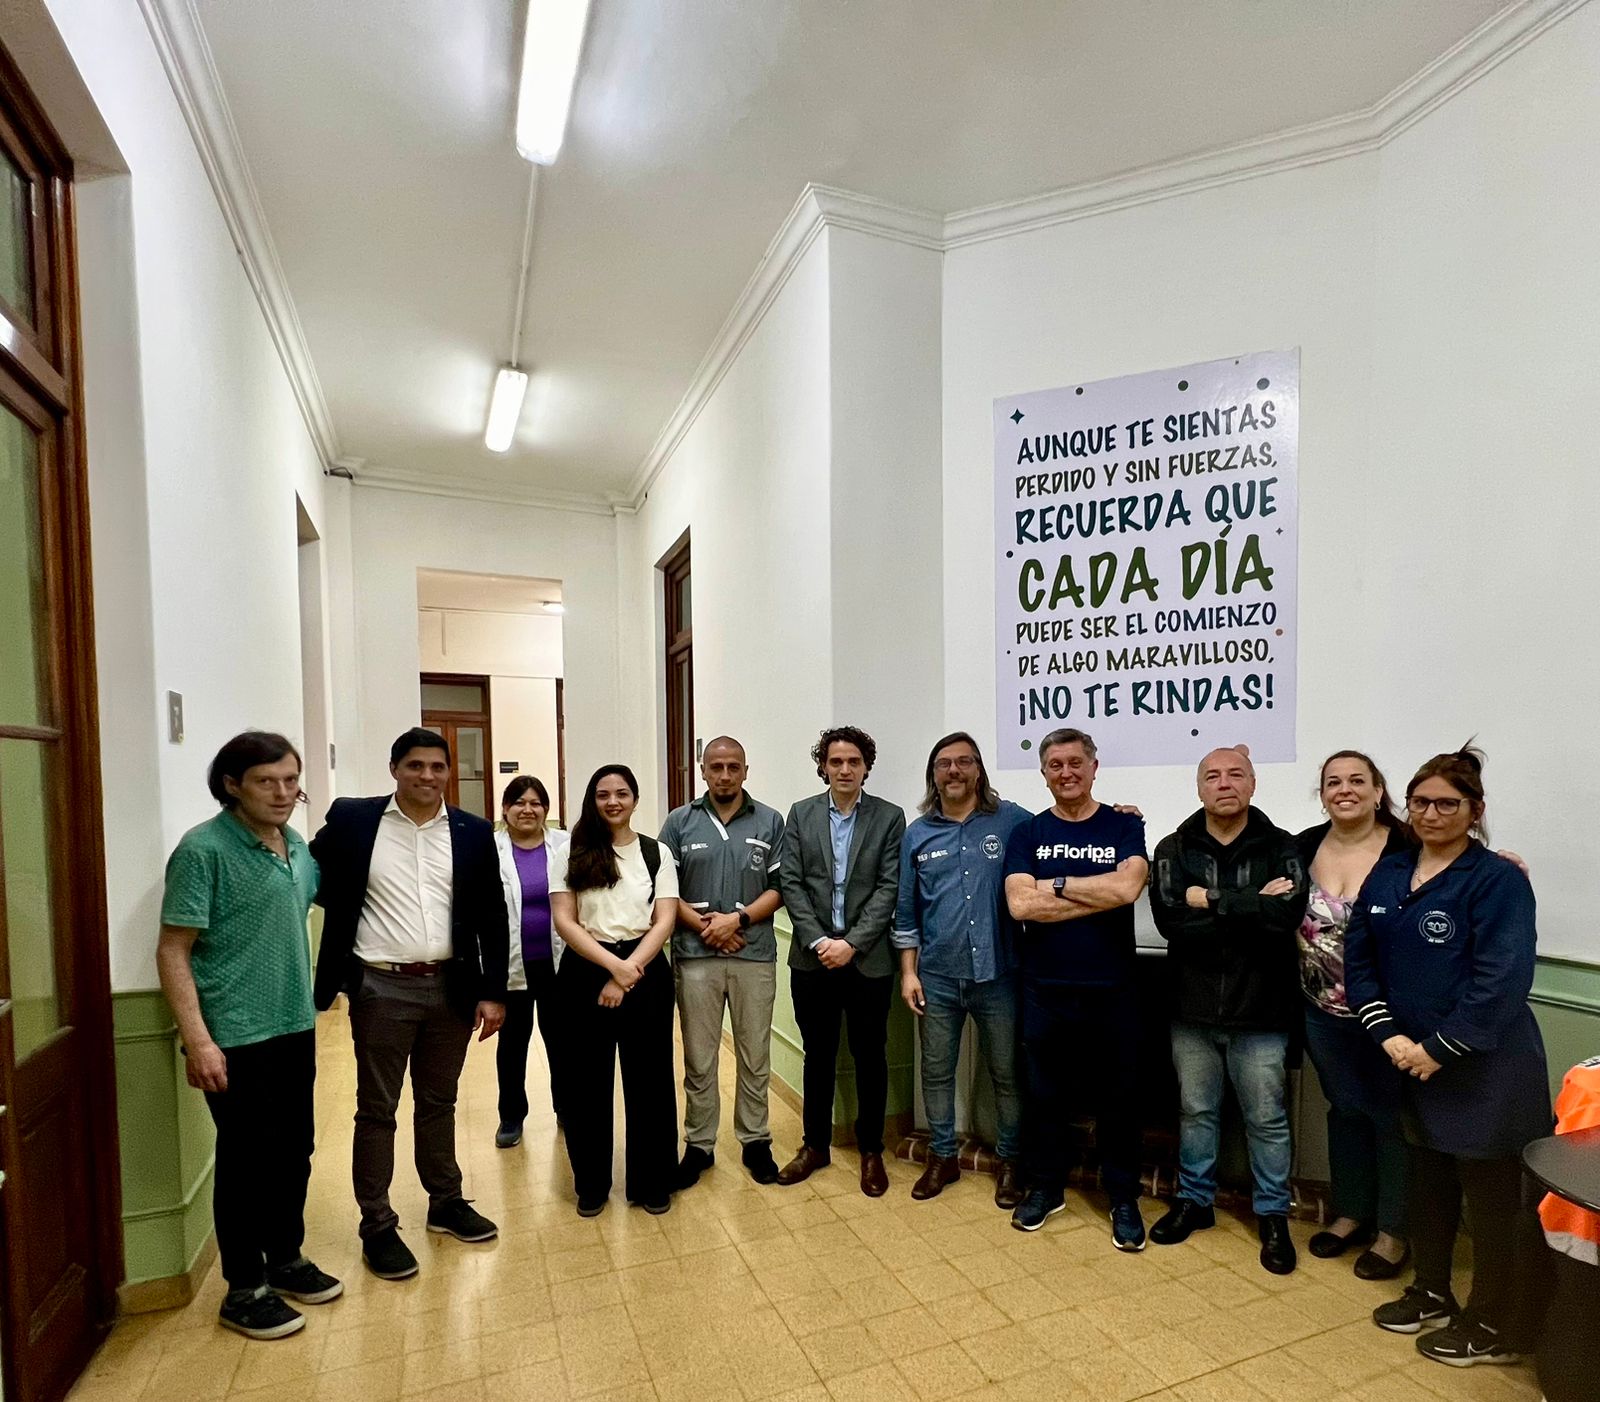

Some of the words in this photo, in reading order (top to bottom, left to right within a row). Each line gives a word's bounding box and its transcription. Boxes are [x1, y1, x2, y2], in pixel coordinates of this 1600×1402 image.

[1016, 423, 1118, 466] AUNQUE
[1124, 417, 1155, 450] TE
[1162, 400, 1277, 444] SIENTAS
[1015, 466, 1096, 499] PERDIDO
[1102, 462, 1119, 487] Y
[1124, 456, 1161, 484] SIN
[1168, 441, 1278, 479] FUERZAS,
[1015, 488, 1192, 546] RECUERDA
[1204, 476, 1279, 525] QUE
[1018, 546, 1160, 613] CADA
[1180, 524, 1275, 601] DÍA
[1016, 617, 1074, 645] PUEDE
[1080, 614, 1120, 640] SER
[1125, 612, 1149, 637] EL
[1154, 601, 1278, 634] COMIENZO
[1018, 654, 1041, 678] DE
[1046, 650, 1099, 675] ALGO
[1106, 638, 1276, 672] MARAVILLOSO,
[1018, 685, 1073, 727] ¡NO
[1082, 681, 1121, 719] TE
[1131, 672, 1275, 717] RINDAS!
[1036, 844, 1116, 863] #Floripa
